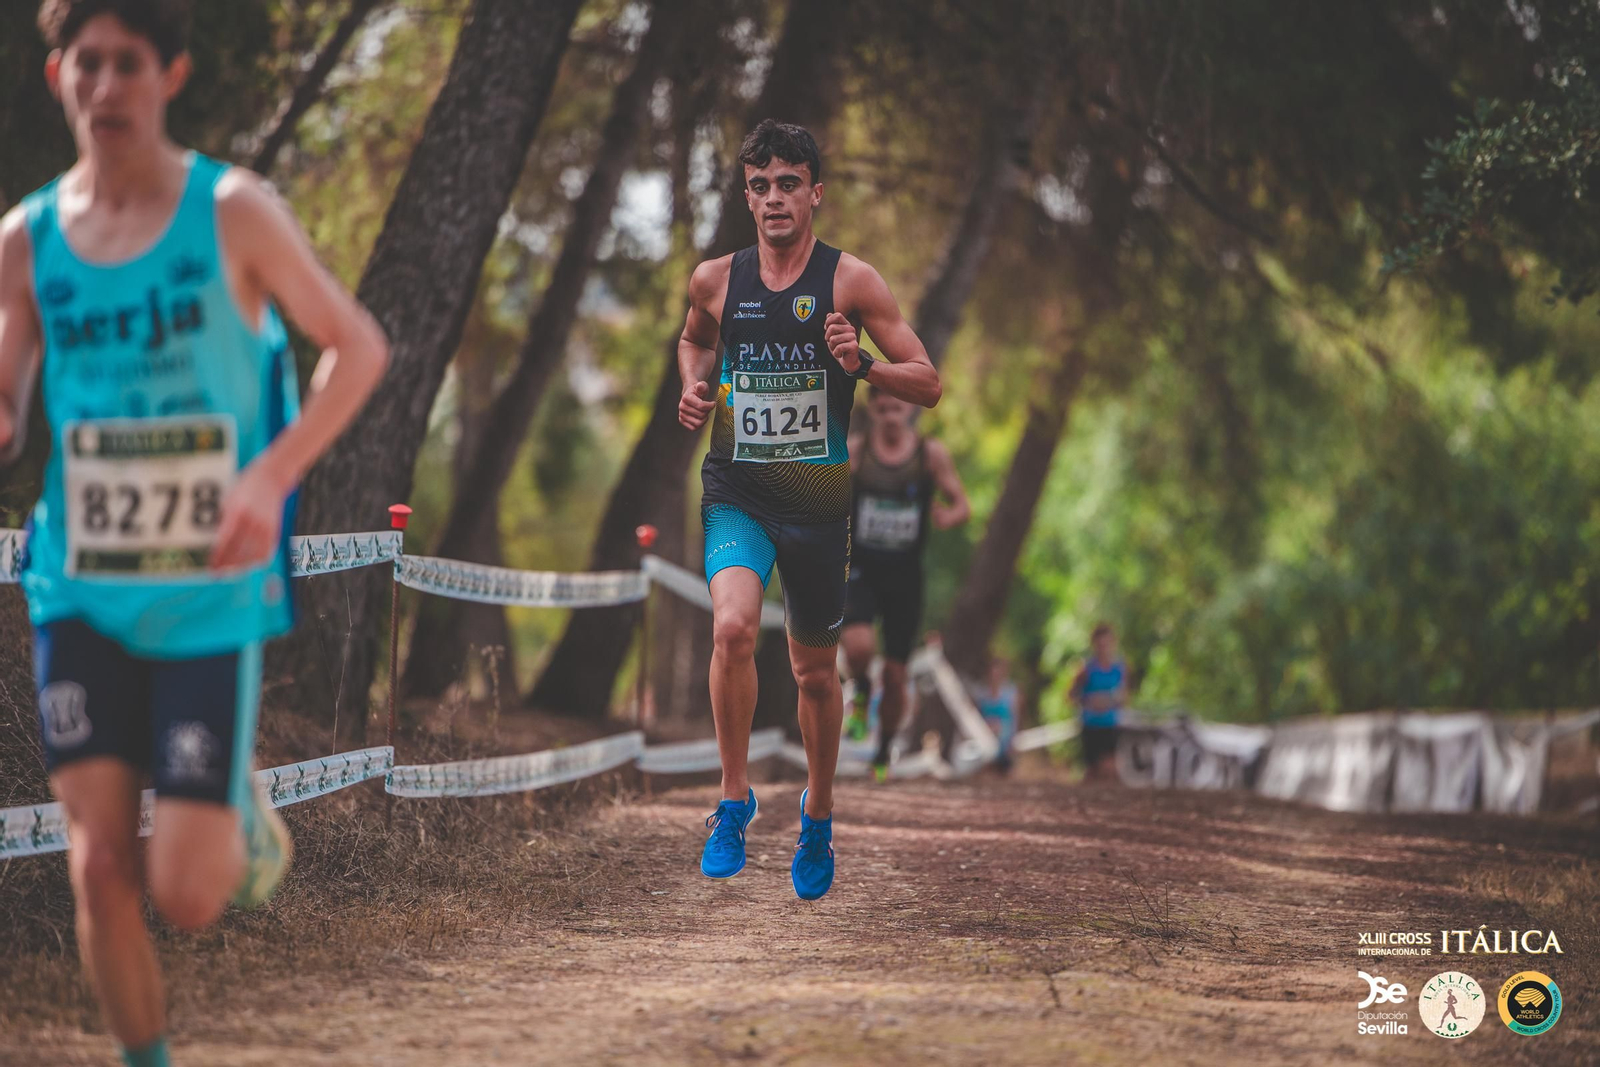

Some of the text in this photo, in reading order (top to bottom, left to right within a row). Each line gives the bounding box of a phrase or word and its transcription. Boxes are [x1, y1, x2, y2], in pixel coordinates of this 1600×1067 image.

[739, 343, 815, 361] PLAYAS
[755, 375, 800, 387] ITÁLICA
[742, 404, 821, 437] 6124
[82, 481, 221, 535] 8278
